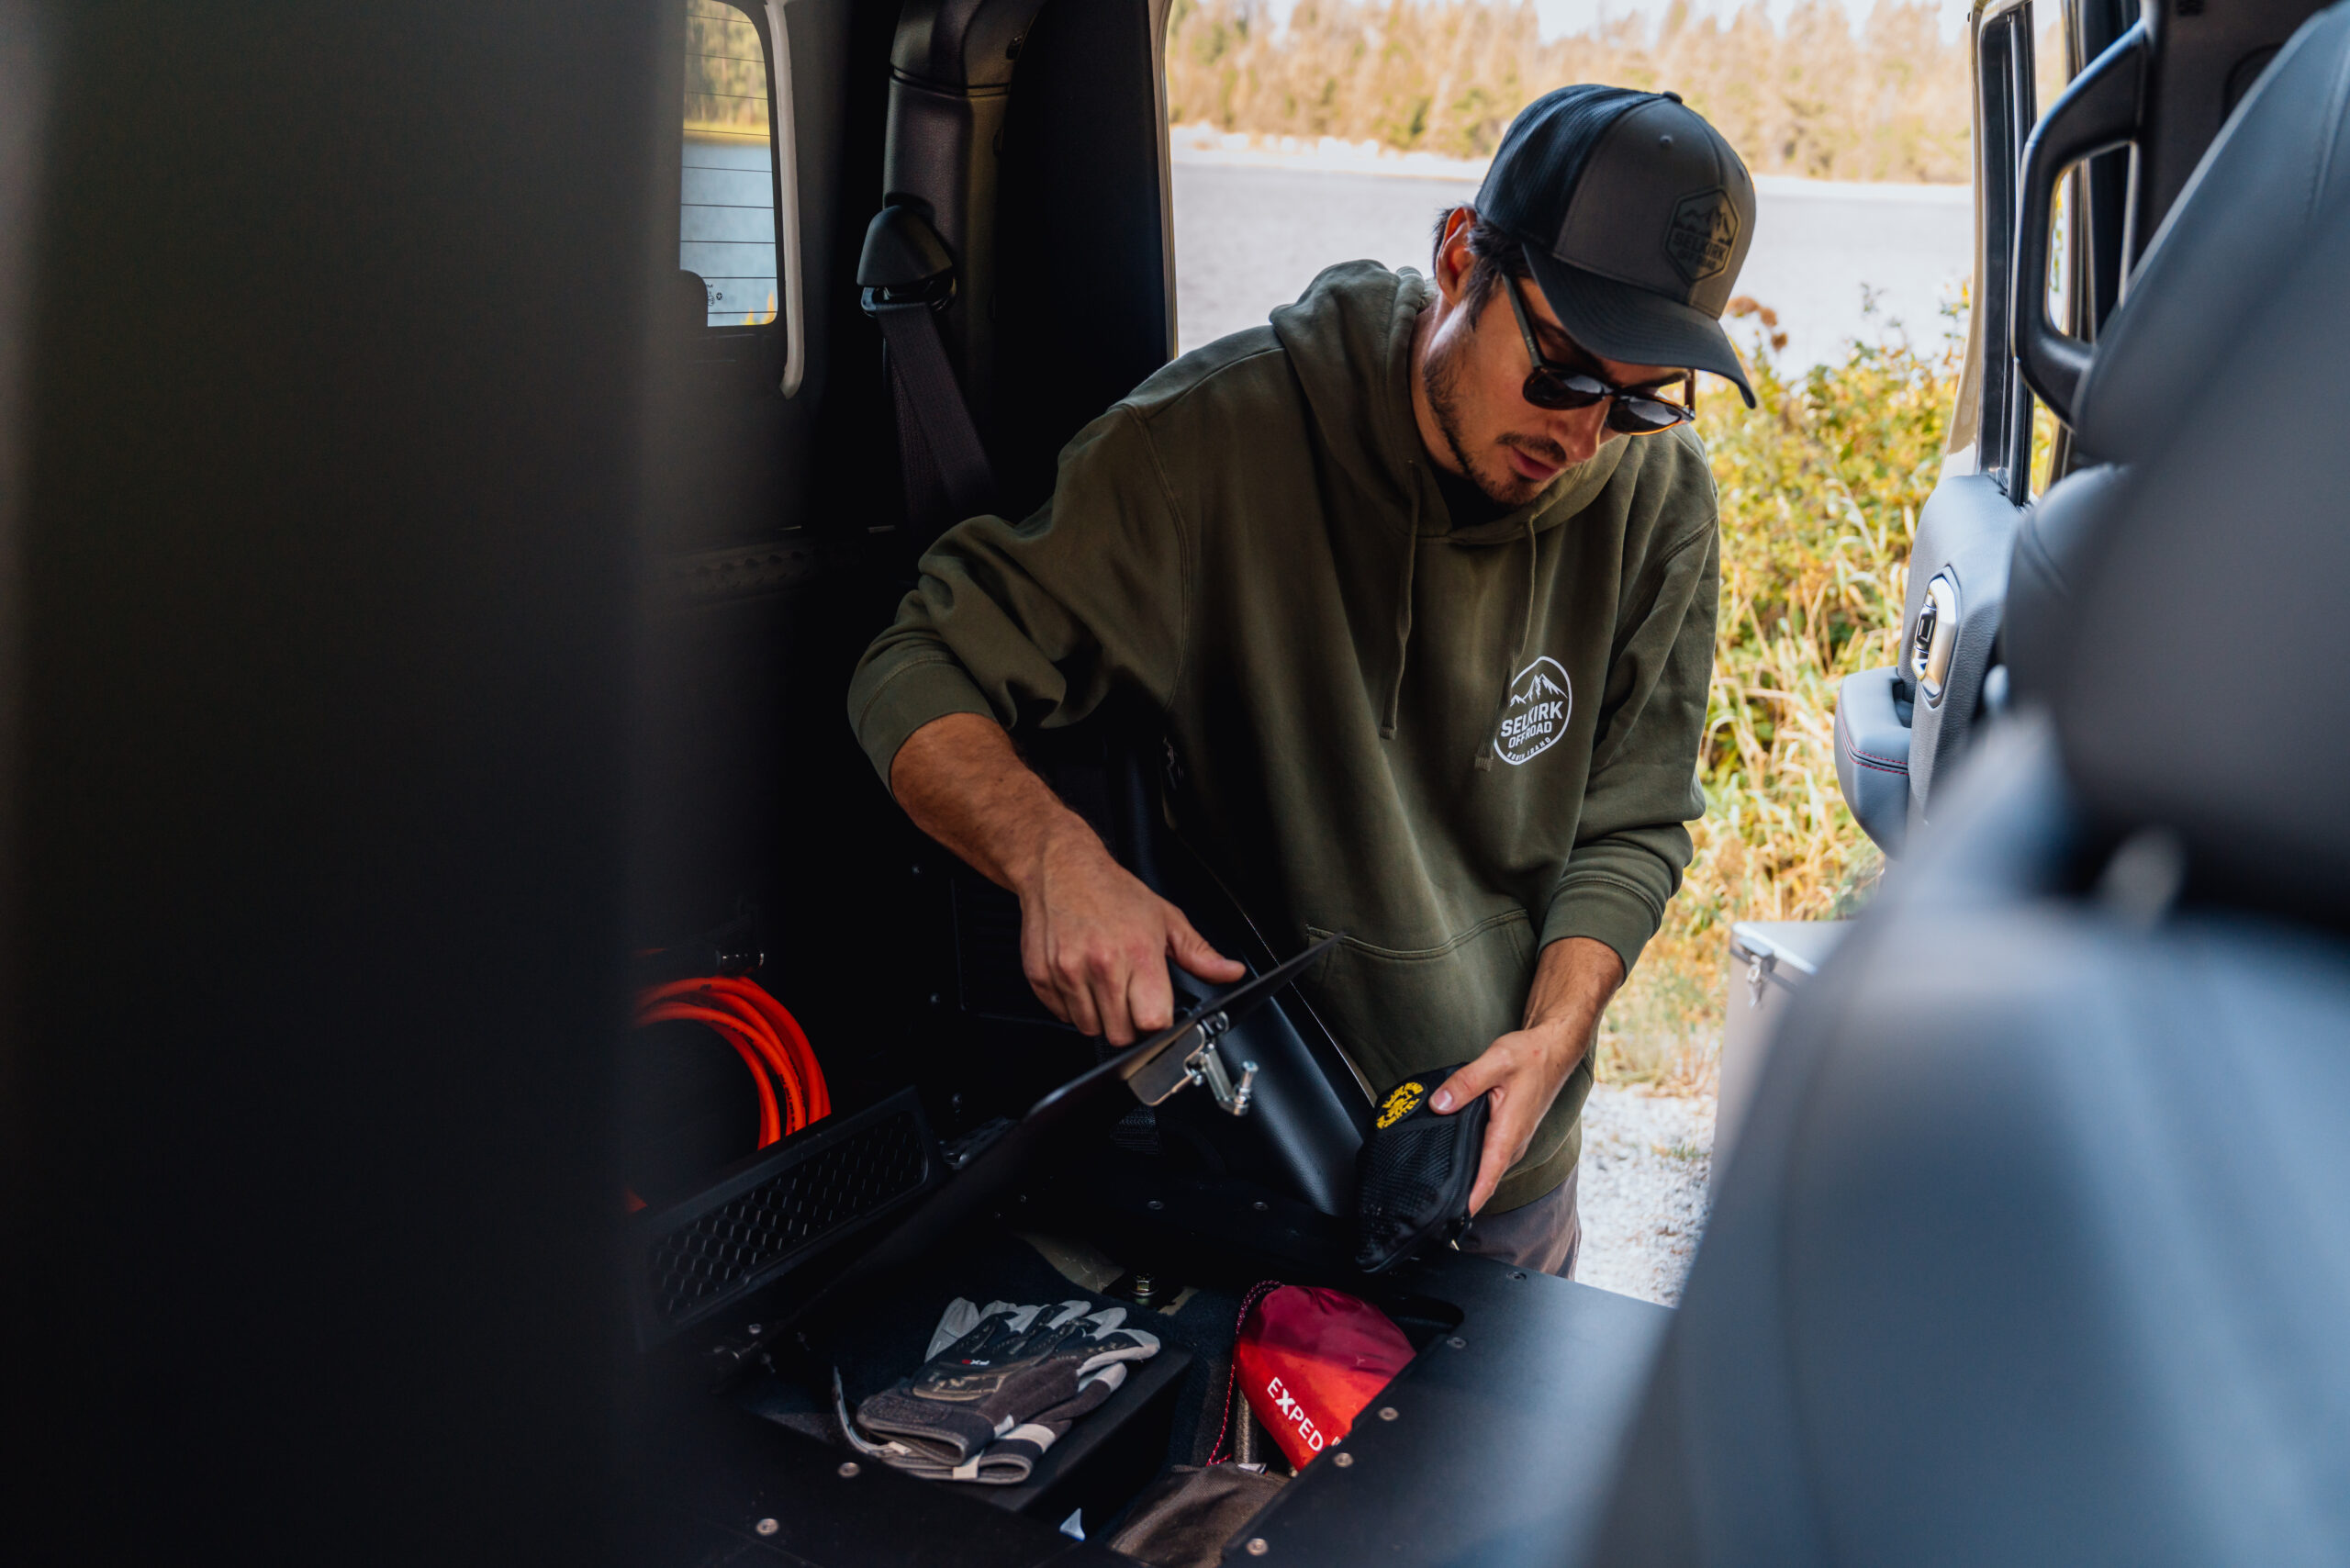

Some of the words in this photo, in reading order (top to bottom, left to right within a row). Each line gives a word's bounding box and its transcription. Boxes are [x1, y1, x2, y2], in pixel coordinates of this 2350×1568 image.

[1673, 230, 1727, 263] SELKIRK
[1500, 700, 1563, 737] SELKIRK
[1507, 721, 1552, 749] OFFROAD
[1267, 1376, 1324, 1451] EXPED
